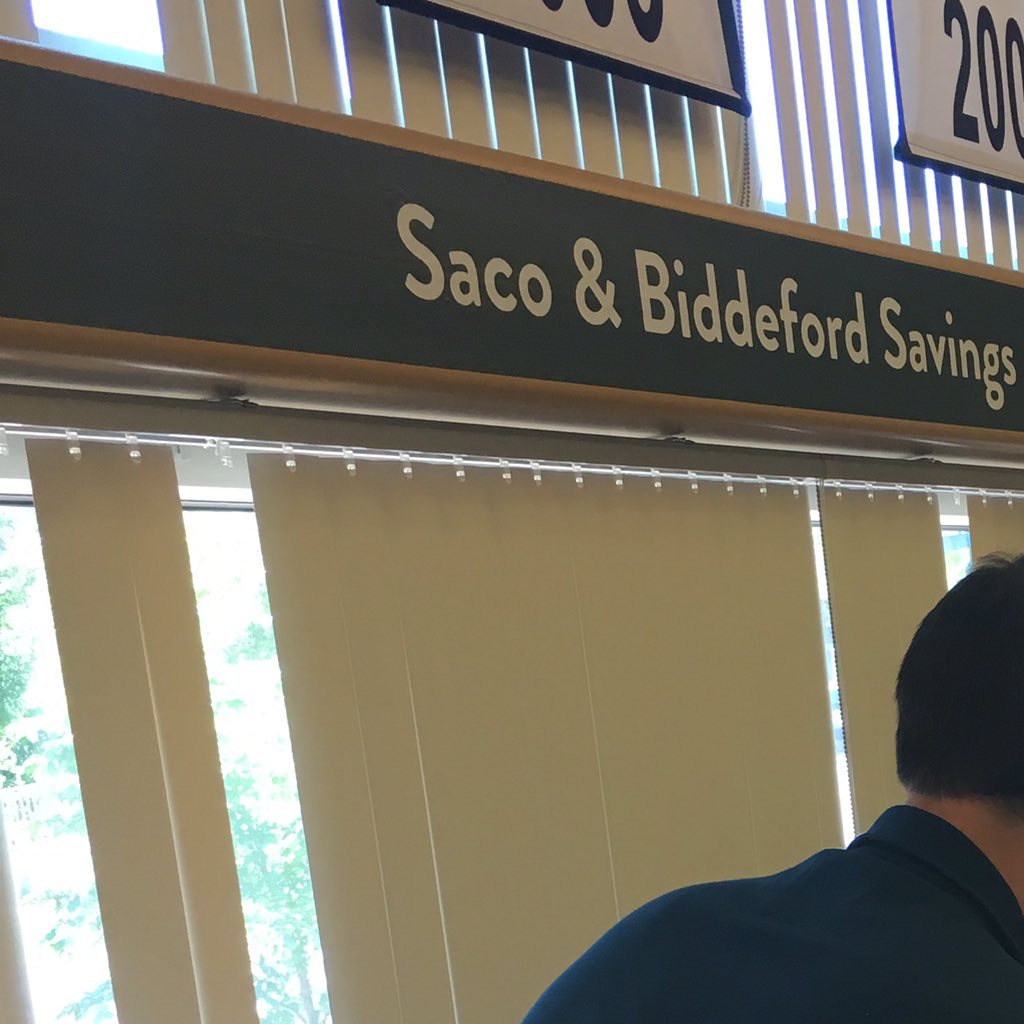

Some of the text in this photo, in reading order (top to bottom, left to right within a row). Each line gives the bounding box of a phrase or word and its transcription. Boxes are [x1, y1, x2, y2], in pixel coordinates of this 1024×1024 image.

[397, 203, 1017, 411] Saco & Biddeford Savings
